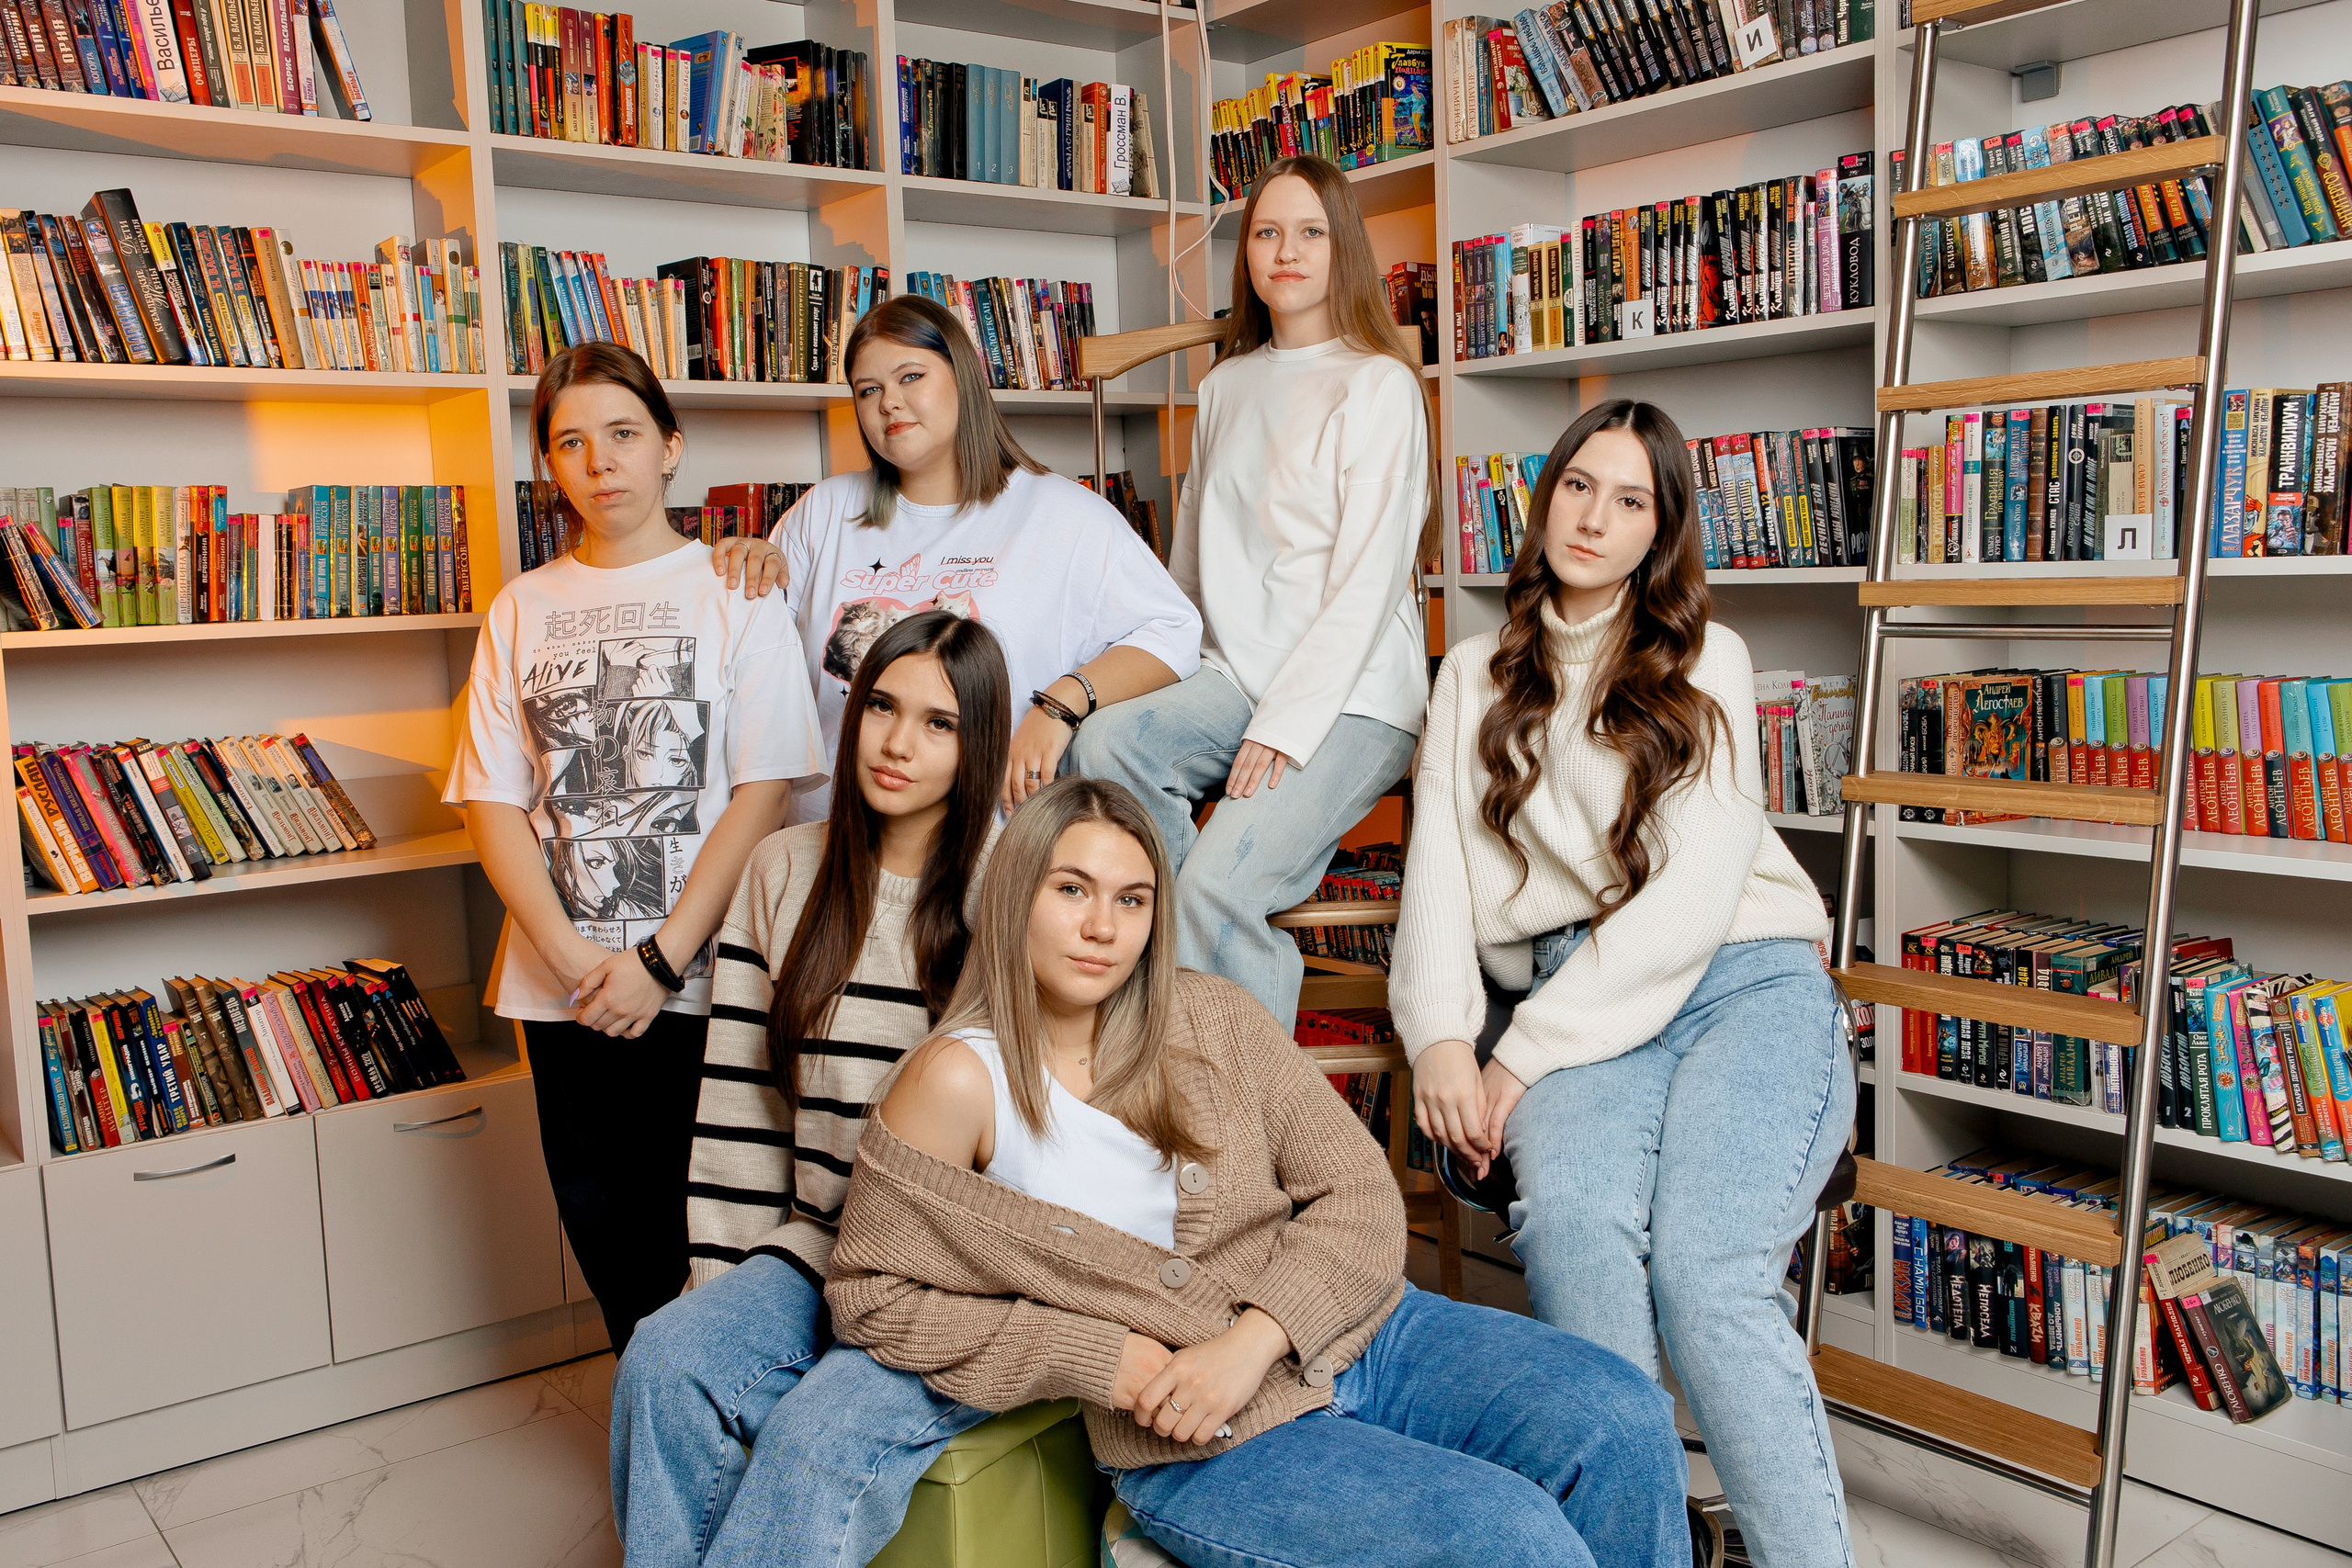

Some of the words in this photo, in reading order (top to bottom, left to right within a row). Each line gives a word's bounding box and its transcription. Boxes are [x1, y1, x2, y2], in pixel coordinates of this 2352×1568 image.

[1746, 28, 1763, 52] И
[1838, 20, 1848, 44] Тайна
[87, 52, 100, 83] КОГОРТА
[188, 38, 204, 85] ОФИЦЕРЫ
[285, 58, 294, 91] БОРИС
[1392, 53, 1425, 69] Главбух
[348, 71, 362, 99] ВАСИЛЬЕВ
[1114, 95, 1125, 107] В.
[1114, 110, 1128, 169] Гроссман
[2125, 188, 2136, 213] КРУЗА
[2324, 172, 2352, 227] АНТИТЕРРОР
[131, 219, 150, 254] КРЕМЛЯ
[2046, 219, 2053, 228] ВО
[2123, 224, 2137, 250] ЗЕМЛЯ
[2132, 215, 2145, 245] АНДРЕЯ
[198, 231, 218, 275] ВАСИНА
[1822, 237, 1830, 256] ДОЧЬ
[1946, 221, 1954, 269] БЛИЗИТСЯ
[2000, 221, 2012, 258] НИЖНИЙ
[2048, 230, 2057, 254] ДВЕРИ
[212, 277, 221, 288] Н.
[1849, 238, 1860, 303] КУКЛОВОД
[136, 269, 164, 333] КРЕМЛЕВСКИЕ
[605, 284, 617, 315] клиника
[1770, 271, 1781, 312] КАЗАНЦЕВ
[108, 283, 147, 352] ВАСИЛЬЕВ
[202, 308, 215, 336] ВАСИНА
[610, 316, 625, 342] потерь
[1633, 312, 1644, 330] К
[211, 338, 221, 359] НИНА
[365, 315, 378, 361] Веденская
[982, 302, 1003, 365] ЦИКЛОГЕКСАН
[2318, 392, 2328, 433] МИХАИЛ
[2330, 392, 2340, 433] АНДРЕЙ
[2279, 402, 2299, 488] ТРАНКВИЛИУМ
[2086, 457, 2097, 479] ВОЙНЕ
[2313, 437, 2324, 492] УСПЕНСКИЙ
[2324, 438, 2336, 492] ЛАЗАРЧУК
[1812, 483, 1822, 503] БОЙ
[1985, 468, 1997, 520] ГРАФИНЯ
[2048, 481, 2060, 503] СТАС
[2086, 480, 2096, 493] НА
[2159, 468, 2170, 496] Москва,
[1761, 494, 1770, 505] 12
[2086, 494, 2095, 510] КАК
[1766, 506, 1776, 546] МАРОСЕЙКА
[1817, 508, 1828, 554] ВЕЧНЫЙ
[2084, 511, 2095, 533] ВОЙНЕ
[2084, 535, 2094, 547] НА
[2118, 528, 2136, 549] Л
[460, 547, 469, 591] ВЕРЕСОВ
[947, 556, 972, 564] miss
[973, 556, 993, 567] you
[840, 570, 930, 595] Super
[933, 570, 998, 590] Cute
[544, 602, 680, 642] 起死回生
[553, 651, 569, 660] you
[1820, 704, 1853, 722] Папина
[24, 761, 58, 817] РУСЛАН
[2205, 762, 2218, 823] ЛЕОНТЬЕВ
[76, 807, 90, 831] НИЩАЯ
[216, 792, 239, 821] ВИЛЬМОНТ
[53, 818, 93, 883] ВЕРНЫЙ
[226, 998, 246, 1032] МЕДВЕДЬ
[254, 1010, 268, 1037] Авиатор
[321, 996, 345, 1046] КРЕАТИВА
[158, 1043, 171, 1066] УДАР
[2284, 1033, 2292, 1054] РЕДУТ
[245, 1048, 261, 1072] ВЛАСОВ
[343, 1047, 361, 1082] ВОИНЫ
[2197, 1054, 2207, 1075] РОТА
[2288, 1055, 2298, 1081] ДЕРЖИТ
[163, 1068, 180, 1102] ТРЕТИЙ
[257, 1073, 275, 1105] ВЛАДИМИР
[2292, 1083, 2304, 1111] БАТАРЕЯ
[96, 1100, 107, 1122] АЛЕНА
[99, 1087, 116, 1132] ВИНТЕР
[2198, 1077, 2211, 1129] ПРОКЛЯТАЯ
[1894, 1259, 1911, 1310] ЛУКИН
[2168, 1253, 2210, 1286] ЛЮБЕНКО
[2165, 1302, 2182, 1337] МАГНОЛИЯ
